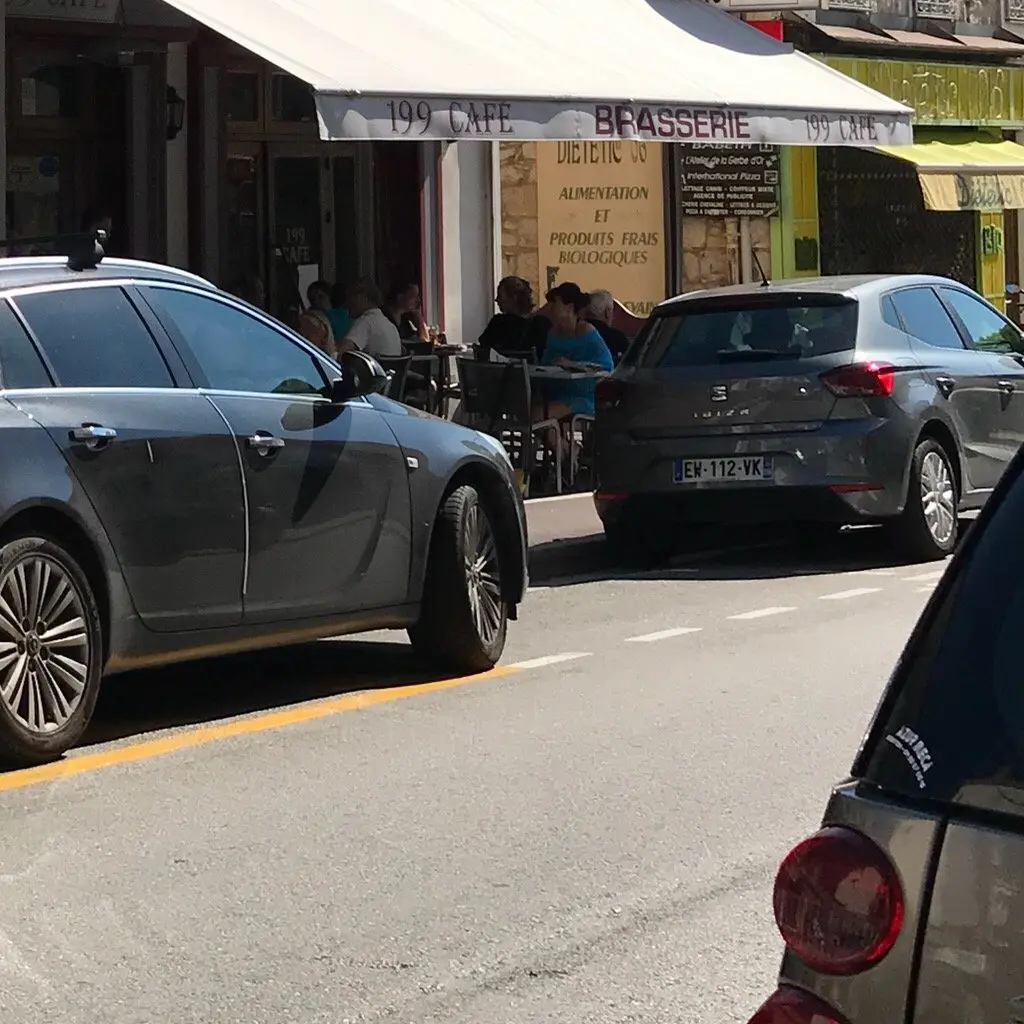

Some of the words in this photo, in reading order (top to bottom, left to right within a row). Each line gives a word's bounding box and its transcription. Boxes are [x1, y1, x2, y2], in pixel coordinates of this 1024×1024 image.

[387, 100, 431, 135] 199
[595, 105, 751, 140] BRASSERIE
[804, 113, 831, 142] 199
[559, 186, 649, 200] ALIMENTATION
[594, 209, 611, 223] ET
[549, 232, 614, 246] PRODUITS
[621, 232, 659, 246] FRAIS
[559, 250, 649, 267] BIOLOGIQUES
